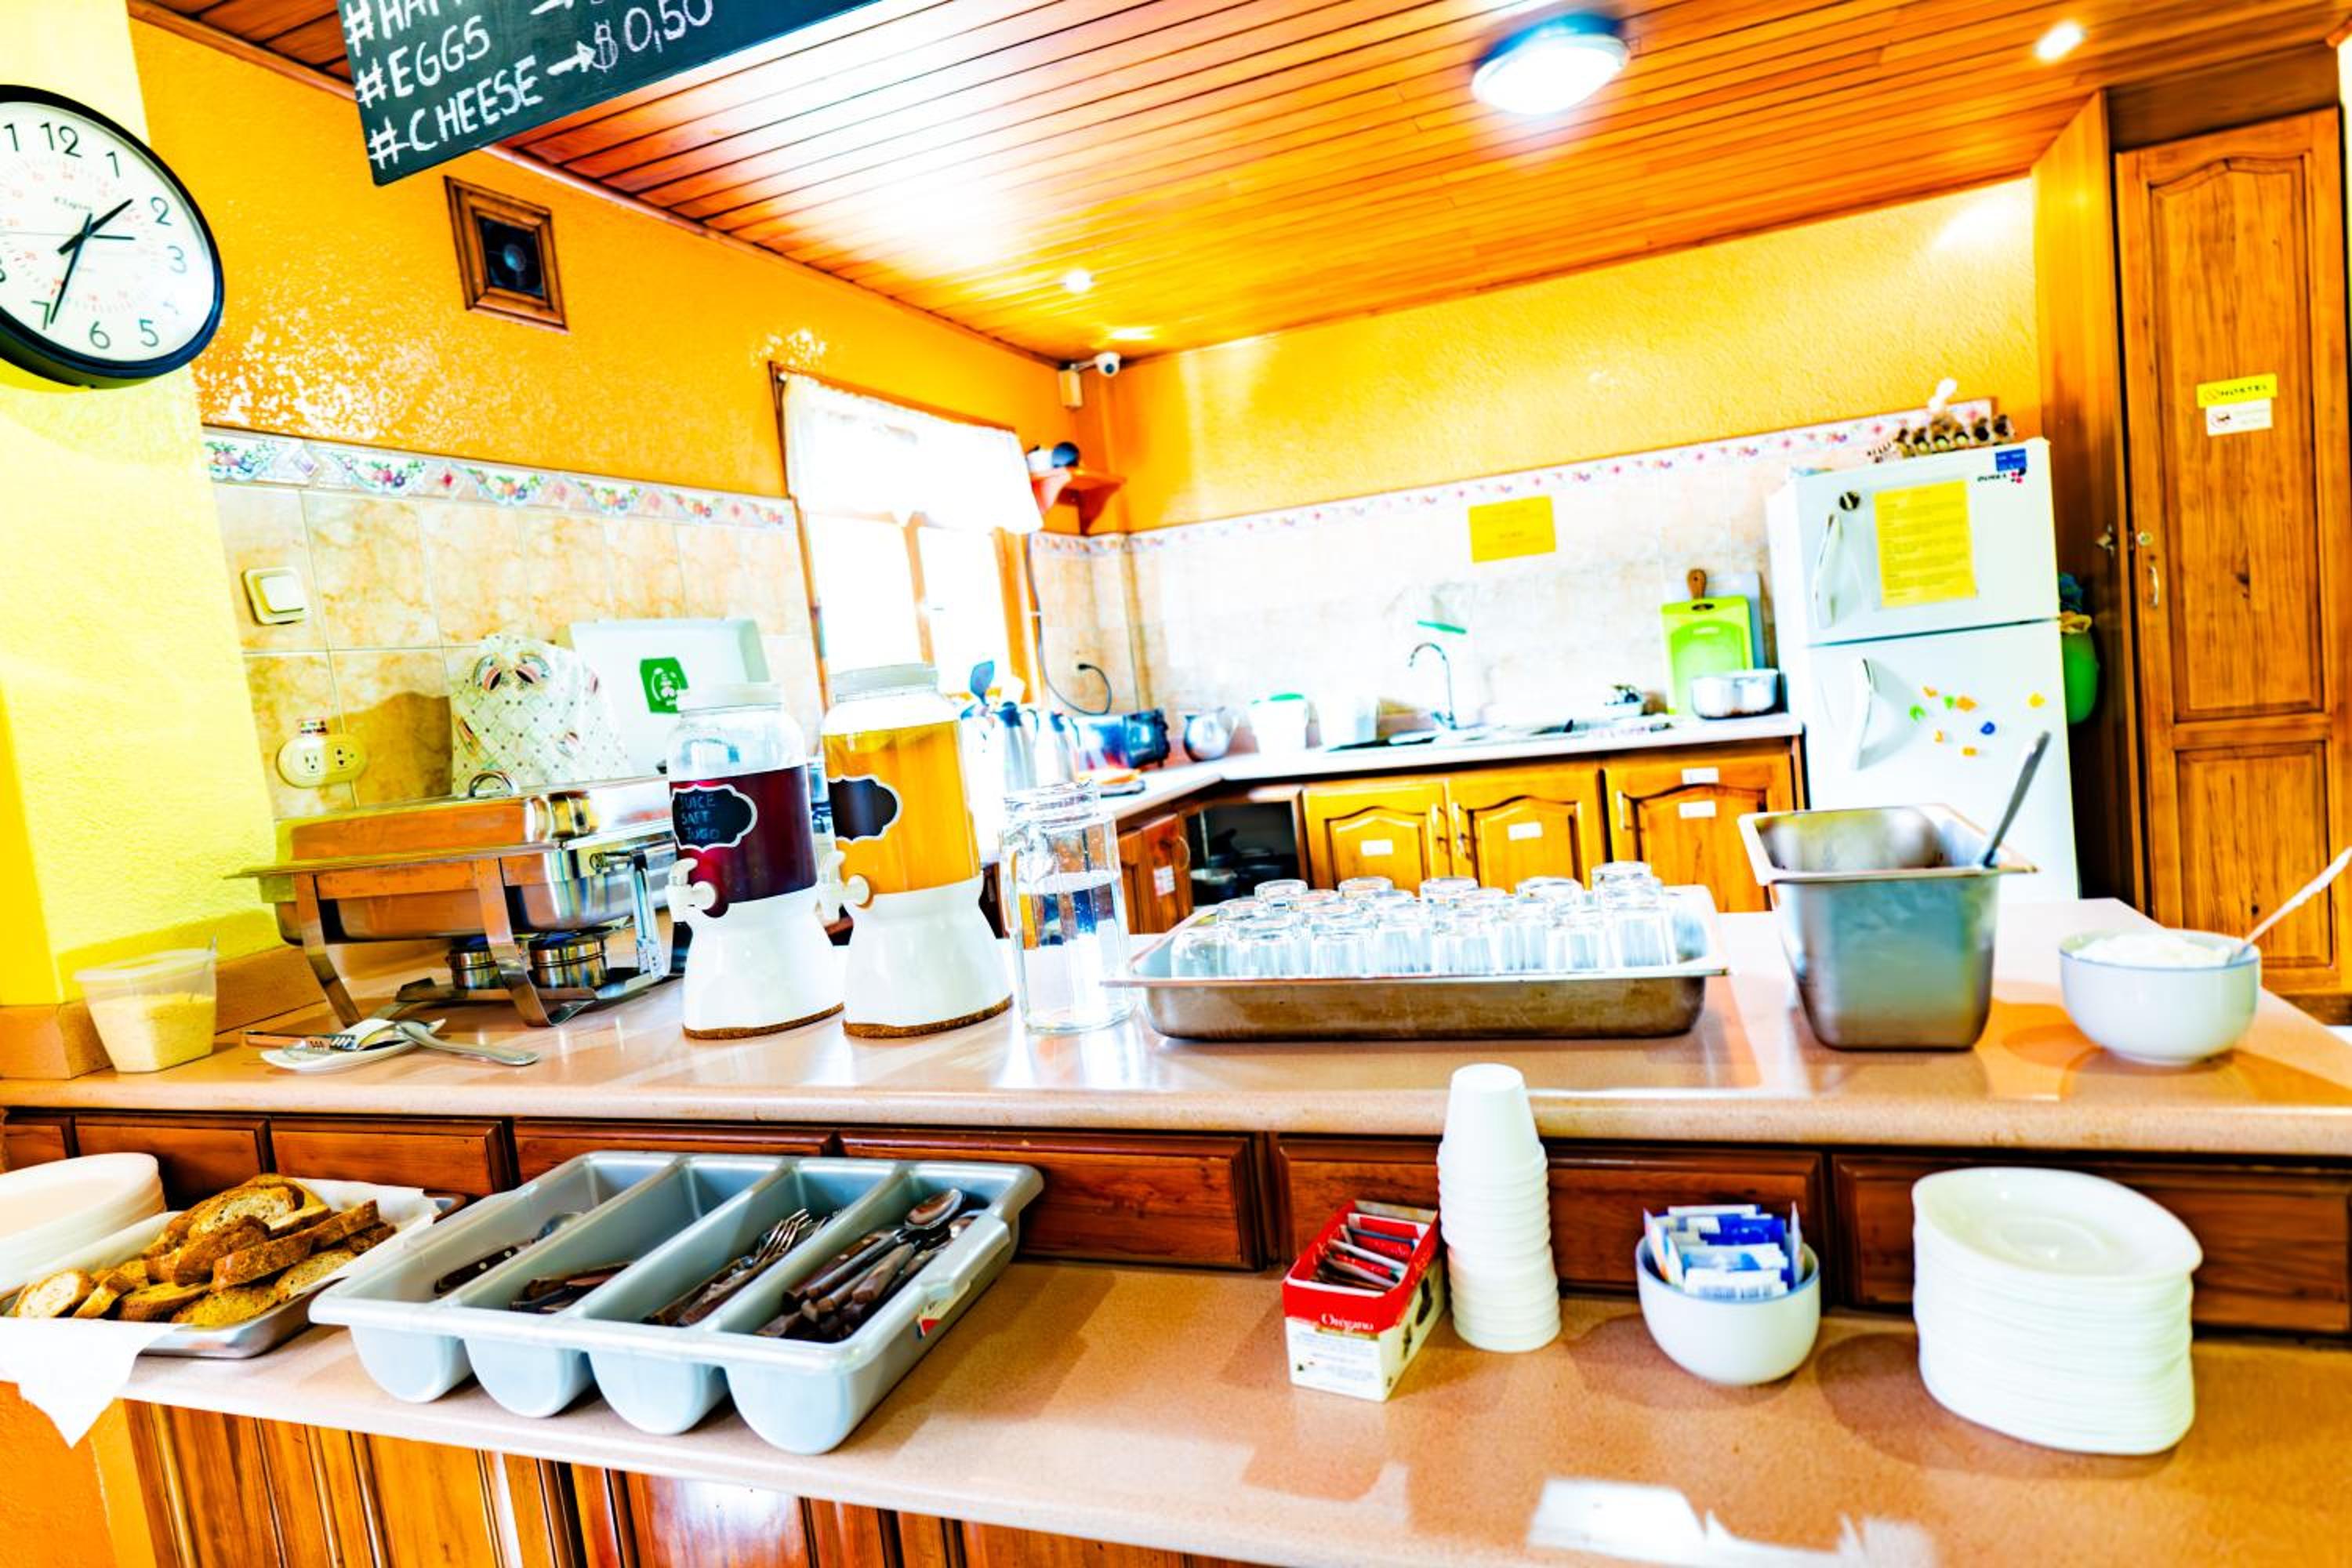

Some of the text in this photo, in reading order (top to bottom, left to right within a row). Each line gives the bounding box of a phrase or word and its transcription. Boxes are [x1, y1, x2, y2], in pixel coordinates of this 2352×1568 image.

[356, 16, 491, 109] #EGGS
[368, 55, 544, 170] #CHEESE
[40, 122, 82, 158] 12
[106, 151, 120, 178] 1
[151, 197, 172, 226] 2
[167, 245, 187, 274] 3
[31, 299, 51, 330] 7
[89, 321, 111, 350] 6
[139, 318, 159, 347] 5
